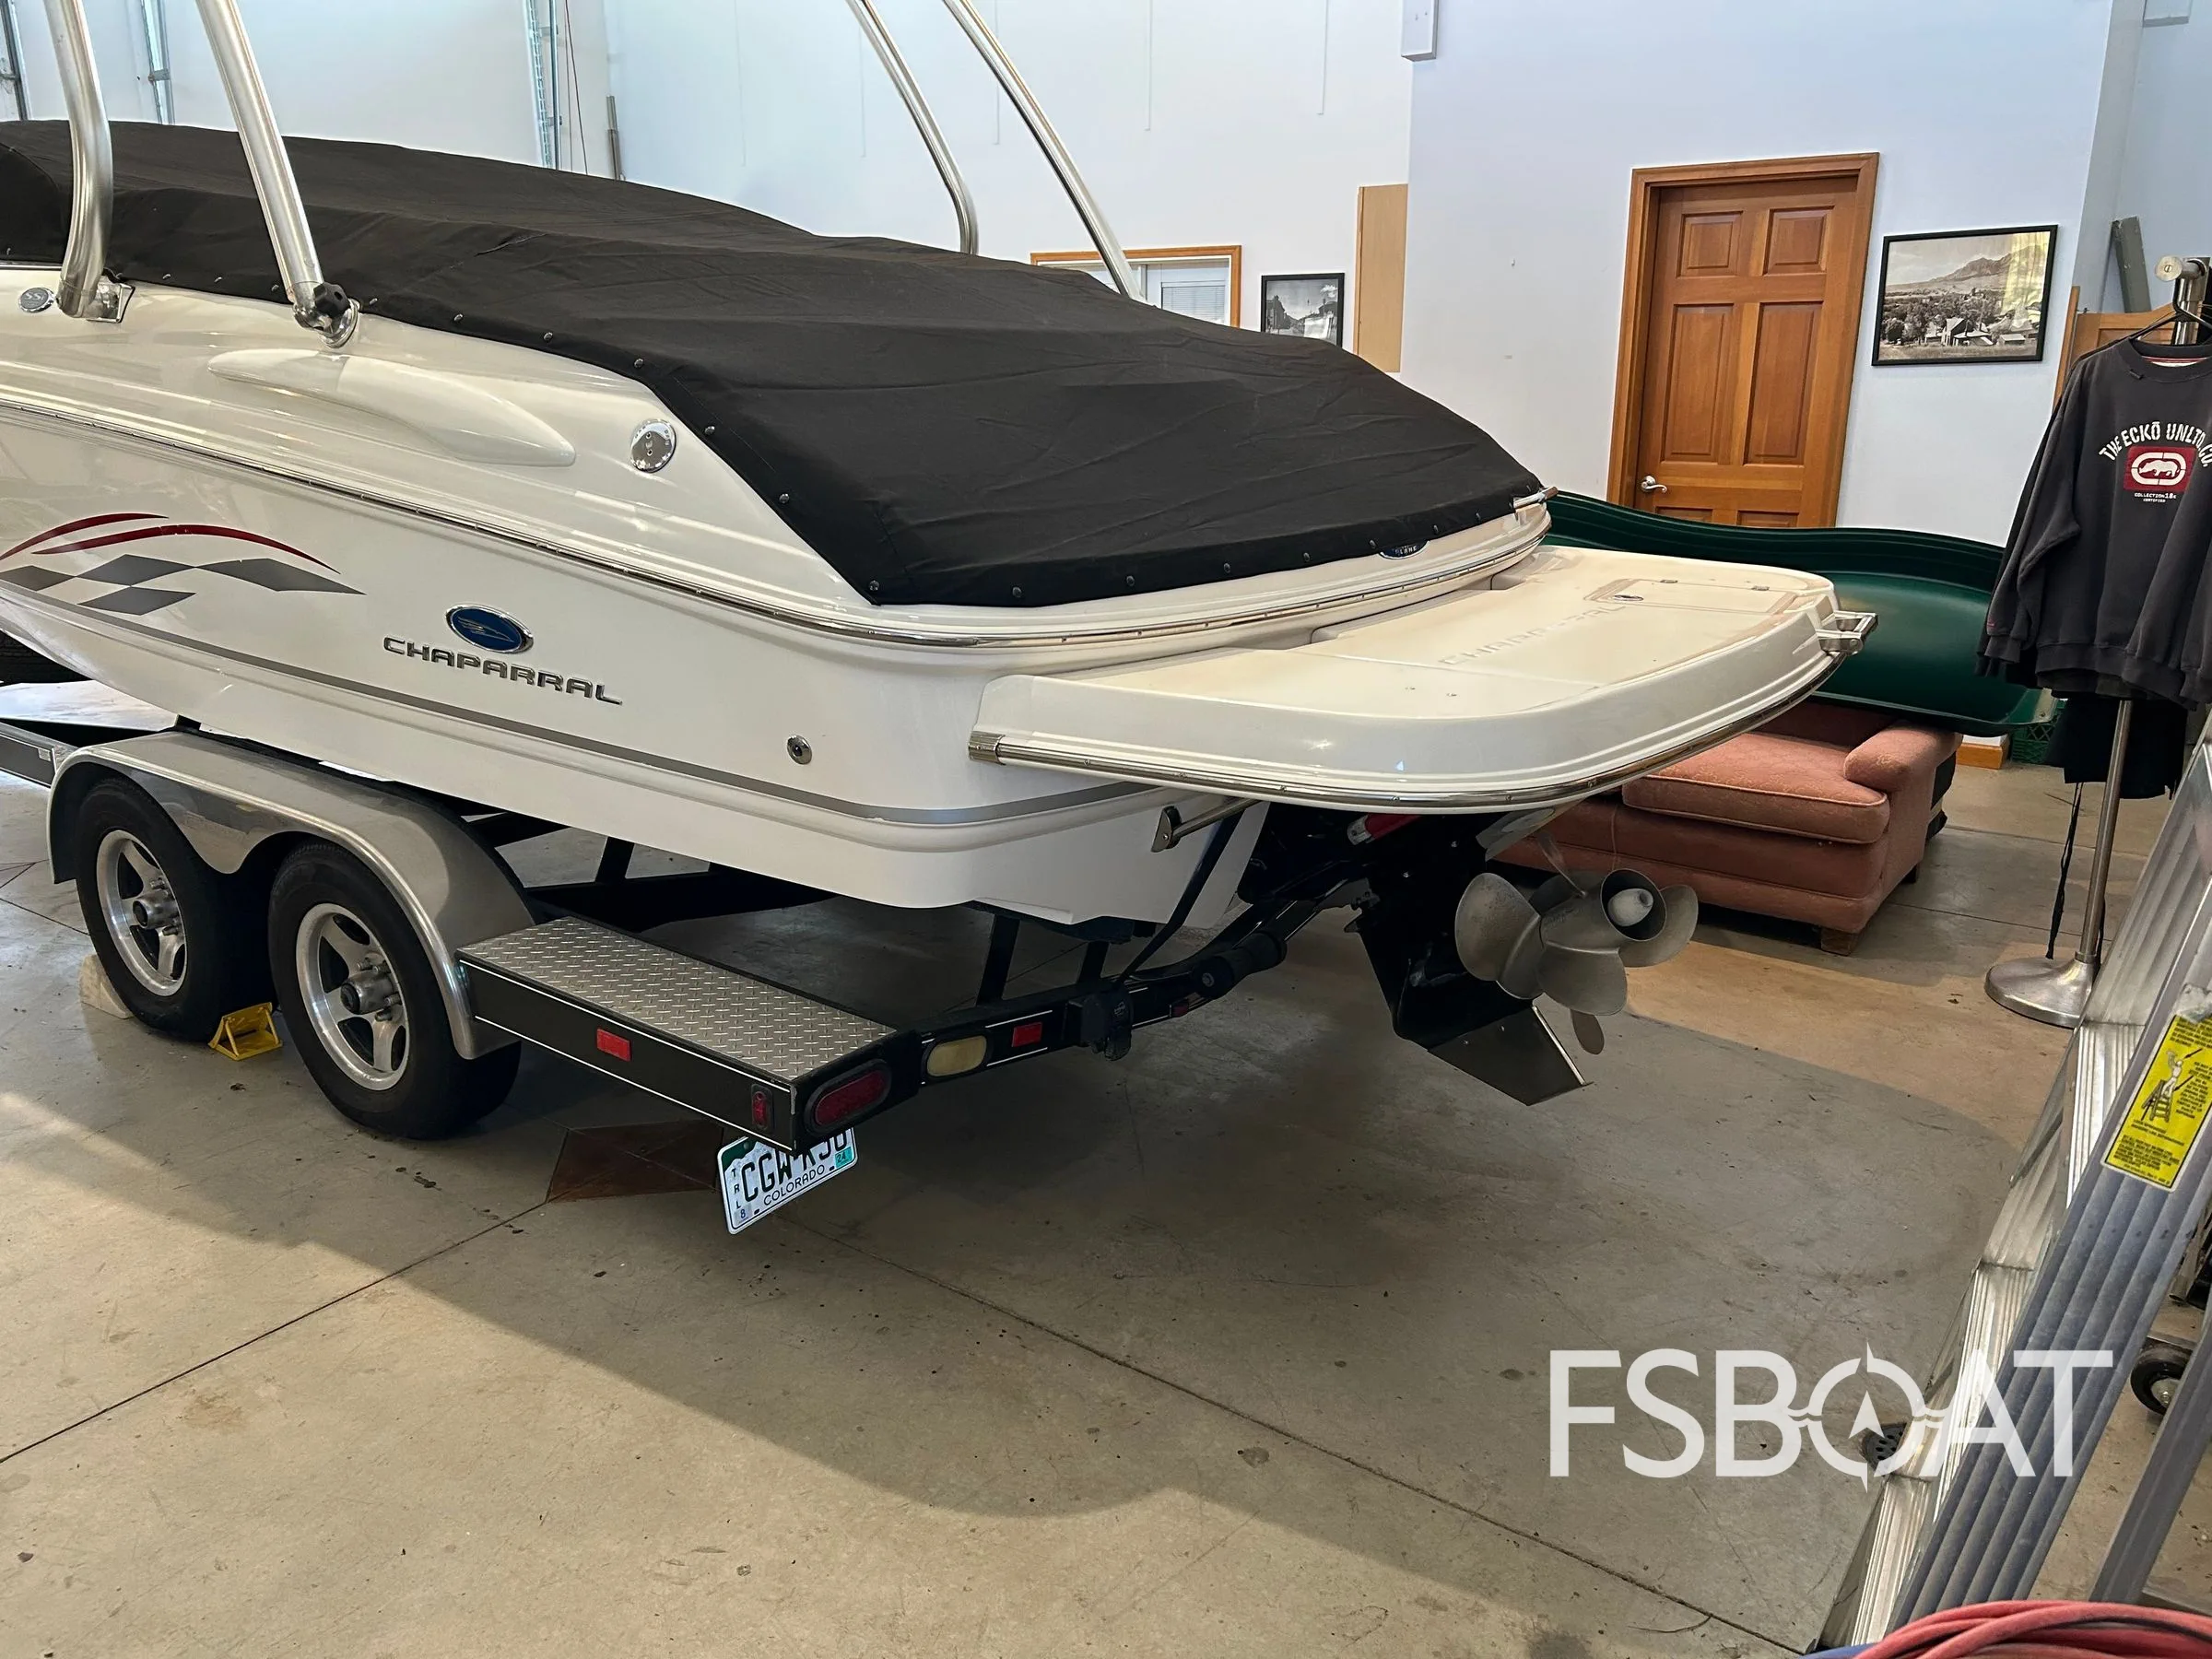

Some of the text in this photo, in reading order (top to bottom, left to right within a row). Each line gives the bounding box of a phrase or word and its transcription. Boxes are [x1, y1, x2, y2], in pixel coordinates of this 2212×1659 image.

[2099, 436, 2123, 461] THE
[1438, 605, 1626, 665] CHAPARAL
[383, 636, 623, 706] CHAPARRAL
[763, 1164, 825, 1206] COLORADO
